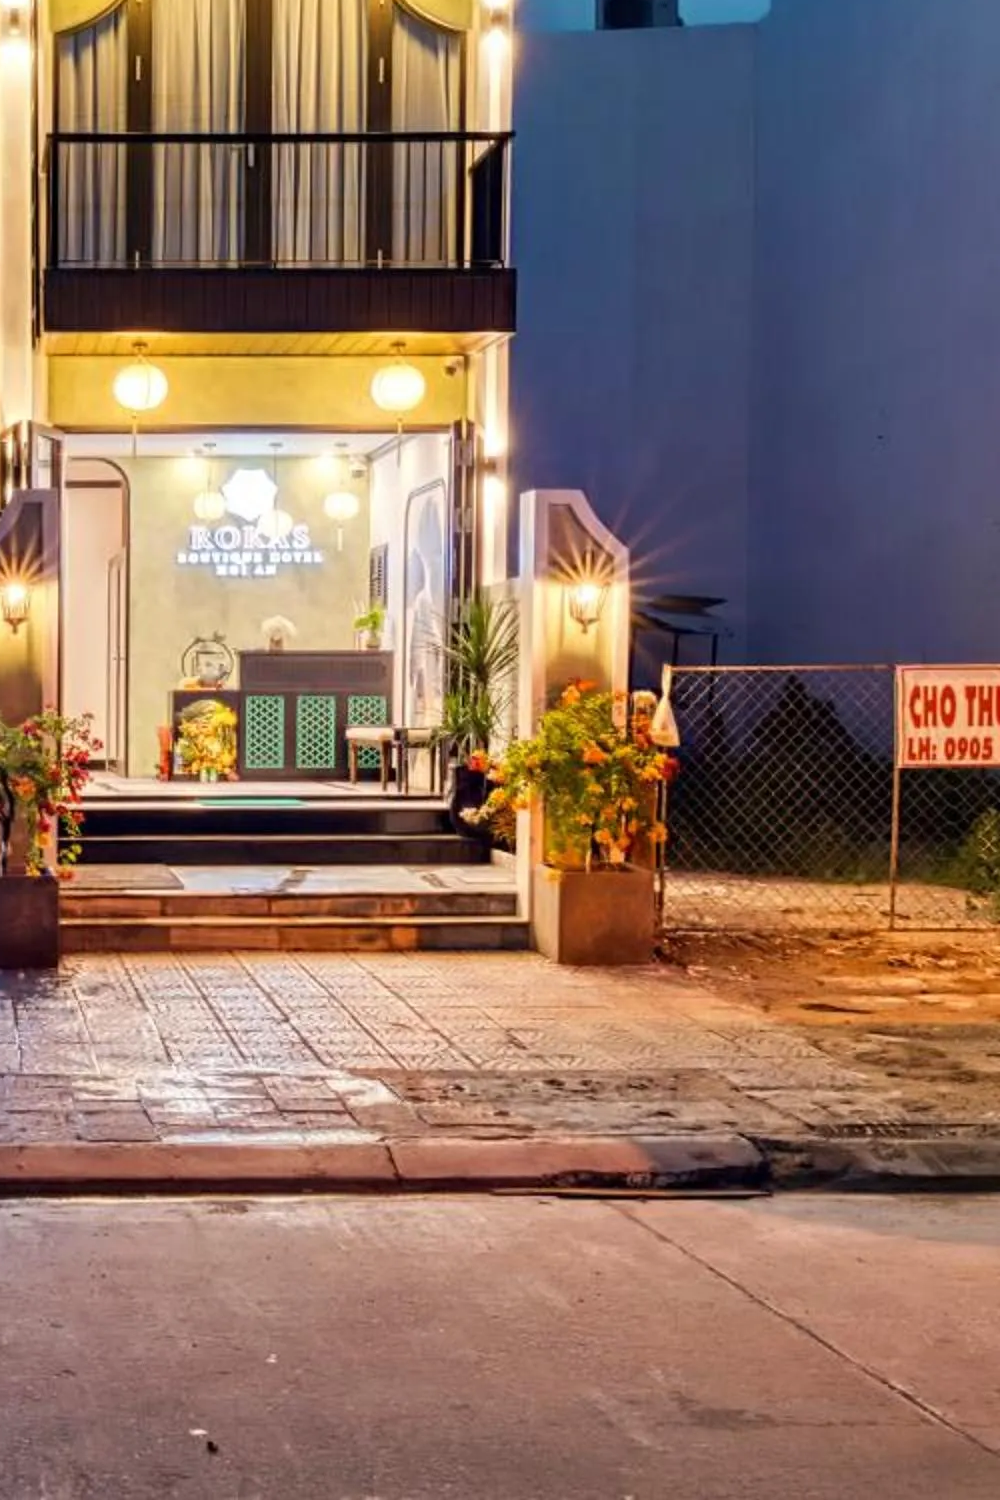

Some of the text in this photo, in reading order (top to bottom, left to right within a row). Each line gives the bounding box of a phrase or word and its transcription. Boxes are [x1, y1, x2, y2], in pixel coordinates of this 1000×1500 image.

[177, 551, 323, 565] BOUTIQUE HOTEL
[909, 684, 956, 729] CHO
[908, 737, 993, 761] LH: 0905
